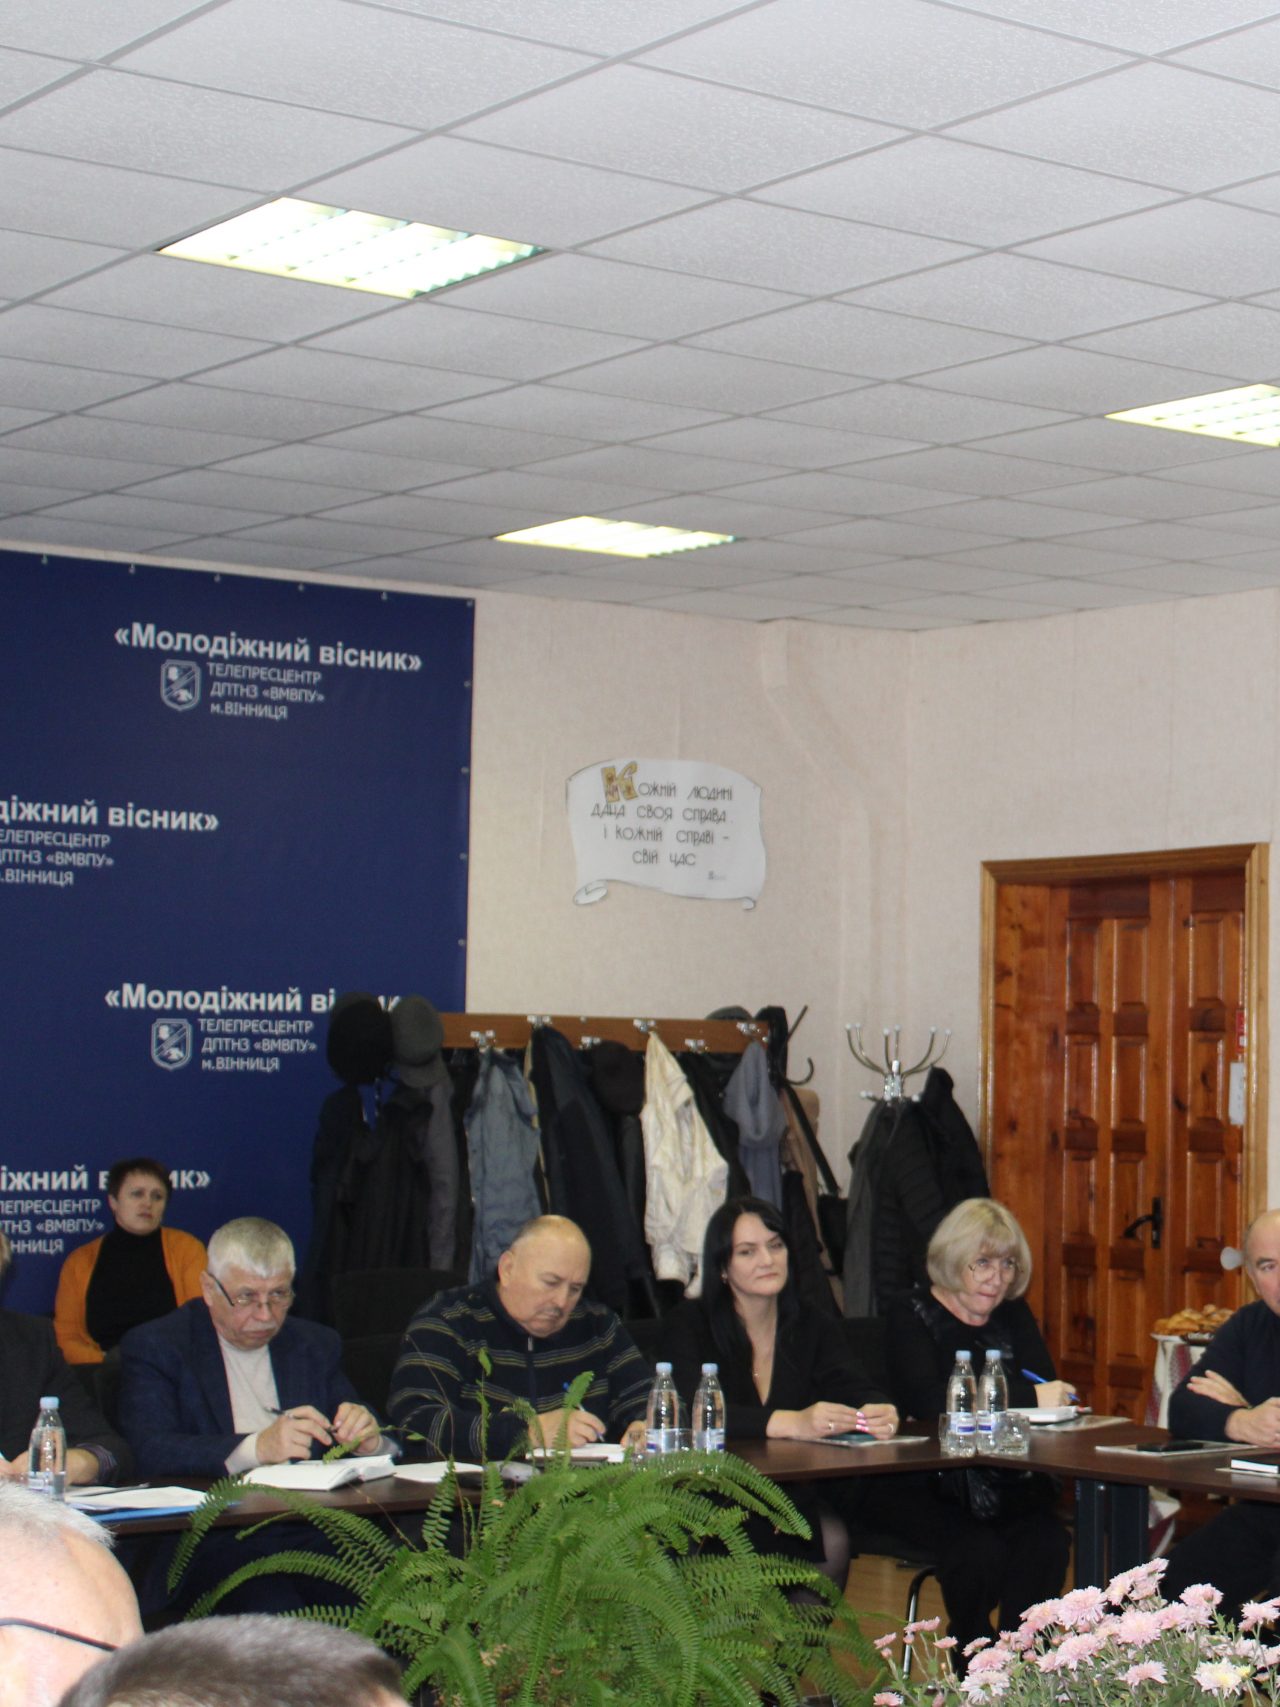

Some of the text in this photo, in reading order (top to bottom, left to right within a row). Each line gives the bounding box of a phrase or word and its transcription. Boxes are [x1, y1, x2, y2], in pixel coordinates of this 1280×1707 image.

[114, 621, 422, 672] «Молодіжний вісник»
[207, 662, 321, 685] ТЕЛЕПРЕСЦЕНТР
[210, 682, 325, 703] ДПТНЗ «ВМВПУ»
[210, 703, 288, 721] м.ВІННИЦЯ
[108, 802, 220, 831] вісник»
[46, 851, 114, 868] «ВМВПУ»
[104, 982, 303, 1014] «Молодіжний
[198, 1018, 313, 1035] ТЕЛЕПРЕСЦЕНТР
[201, 1037, 317, 1054] ДПТНЗ «ВМВПУ»
[201, 1057, 280, 1073] м.ВІННИЦЯ
[36, 1218, 104, 1234] «ВМВПУ»
